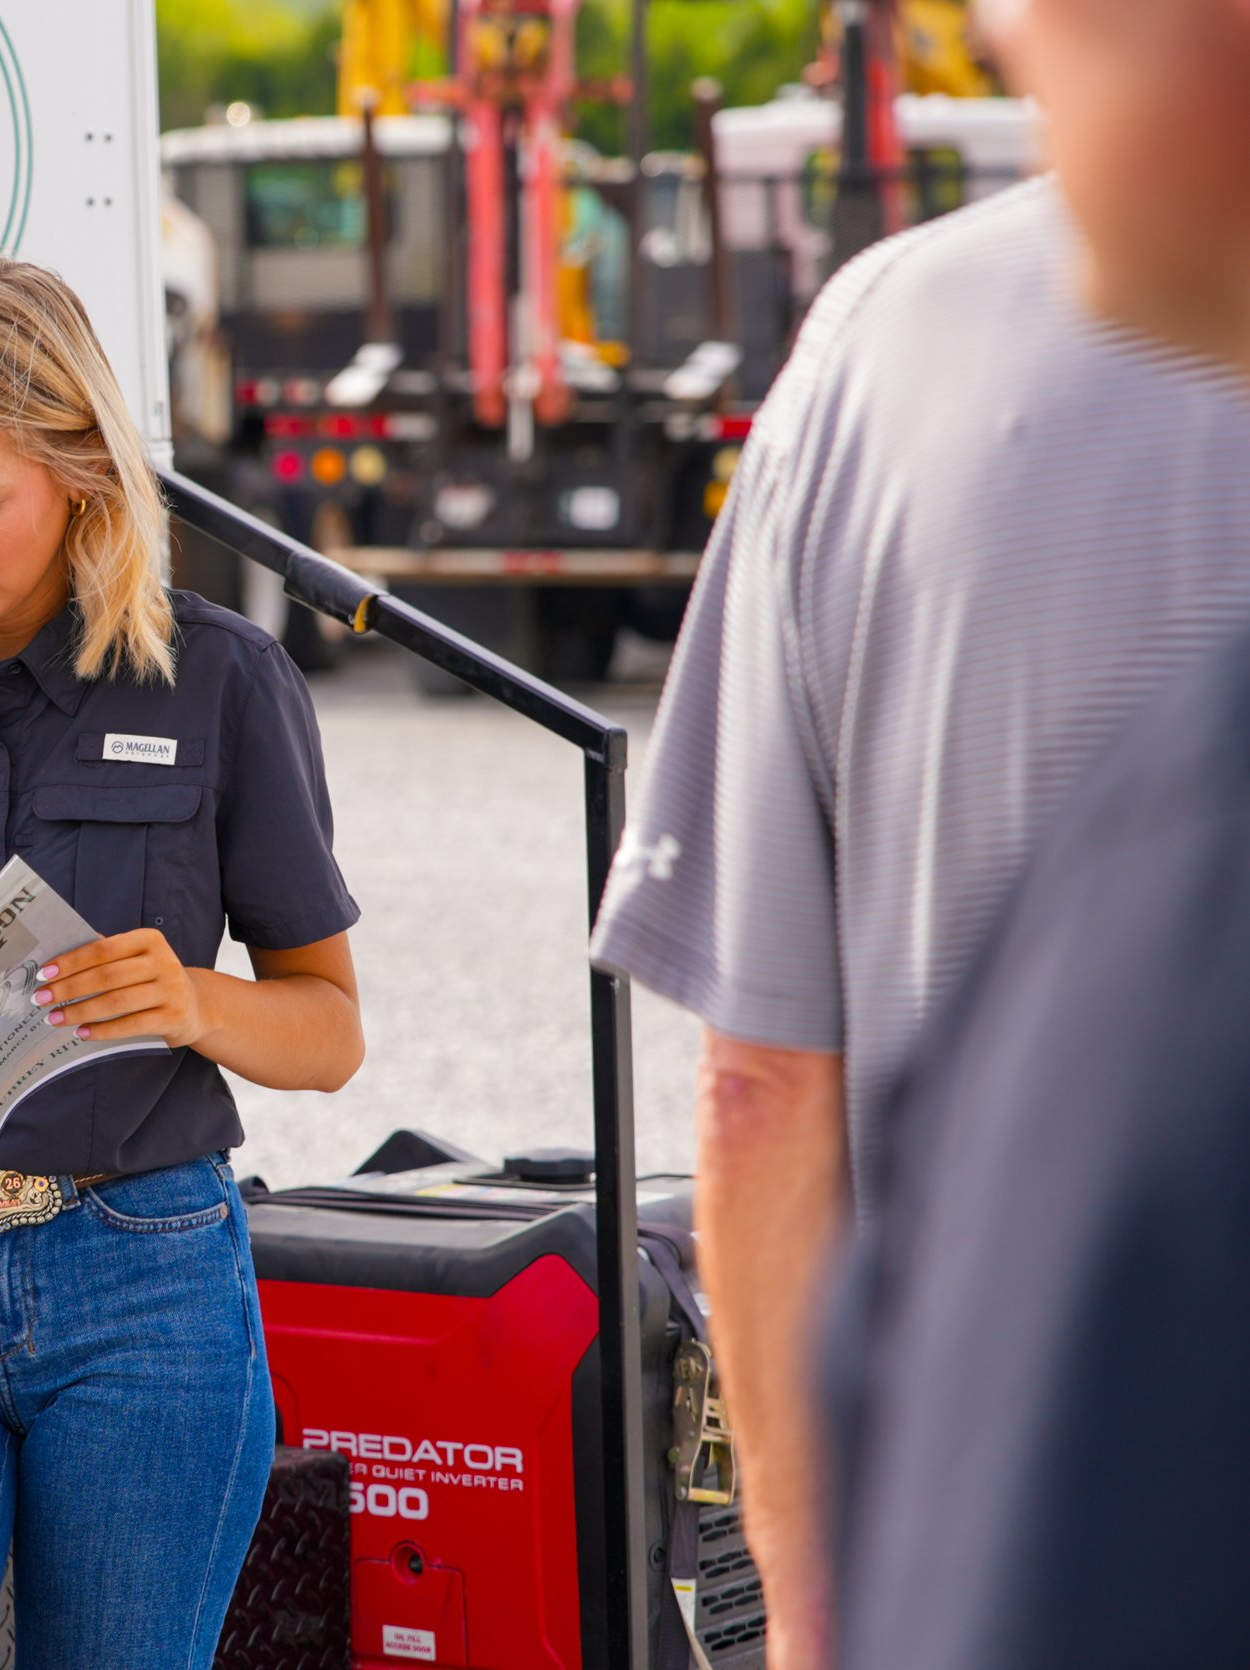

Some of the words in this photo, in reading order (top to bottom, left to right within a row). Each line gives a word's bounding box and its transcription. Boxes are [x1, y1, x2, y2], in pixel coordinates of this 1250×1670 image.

[125, 741, 170, 754] MAGELLAN
[5, 1177, 20, 1190] 26
[302, 1428, 524, 1473] PREDATOR
[371, 1464, 427, 1481] QUIET
[431, 1471, 524, 1492] INVERTER
[349, 1481, 430, 1521] 500
